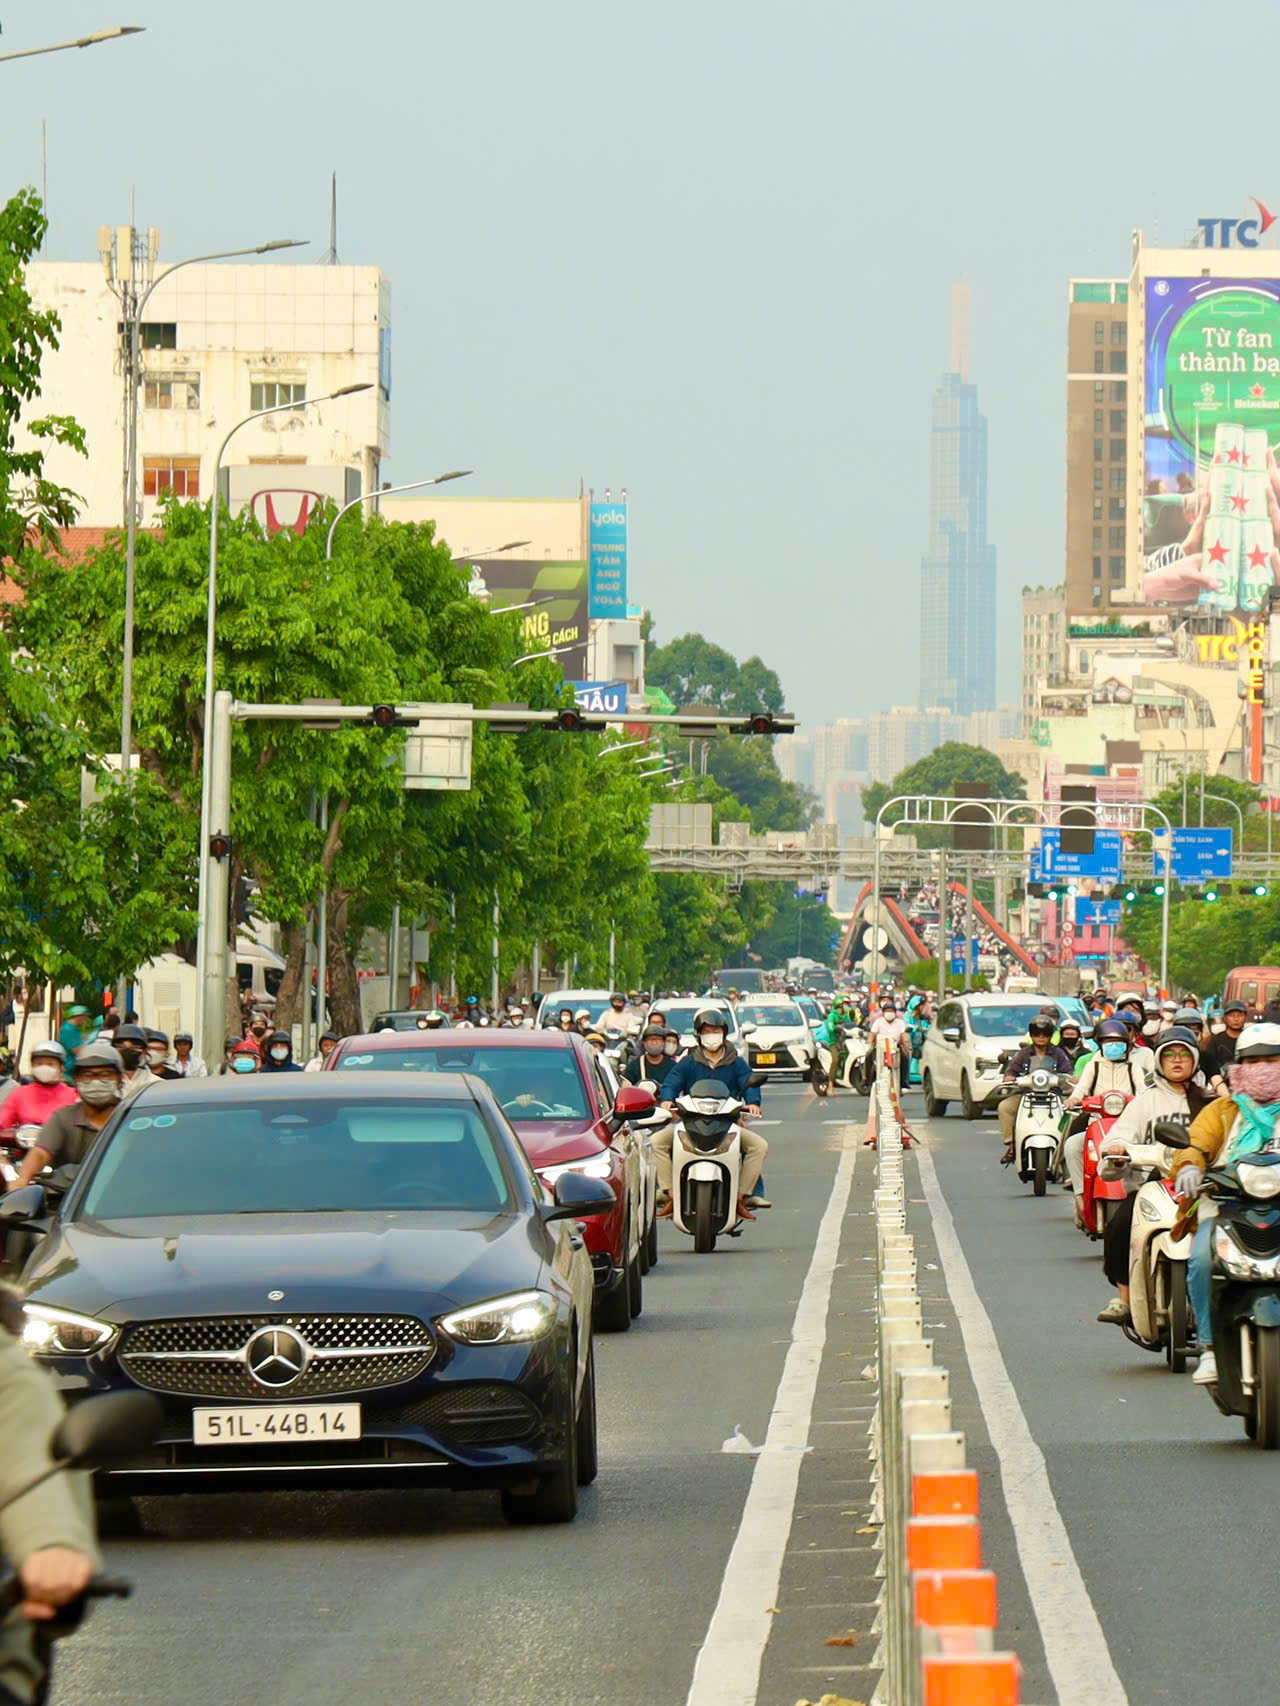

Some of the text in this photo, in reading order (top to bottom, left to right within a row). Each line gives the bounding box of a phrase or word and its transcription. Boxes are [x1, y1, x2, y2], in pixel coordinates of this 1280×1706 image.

[1198, 217, 1259, 248] TTC
[1201, 326, 1273, 349] Từ fan
[1179, 351, 1247, 373] thành
[591, 509, 625, 528] yola
[593, 595, 623, 606] YOLA
[520, 611, 550, 640] NG
[552, 626, 579, 647] CÁCH
[1195, 622, 1265, 704] TTC HOTEL
[208, 1411, 346, 1438] 51L-448.14
